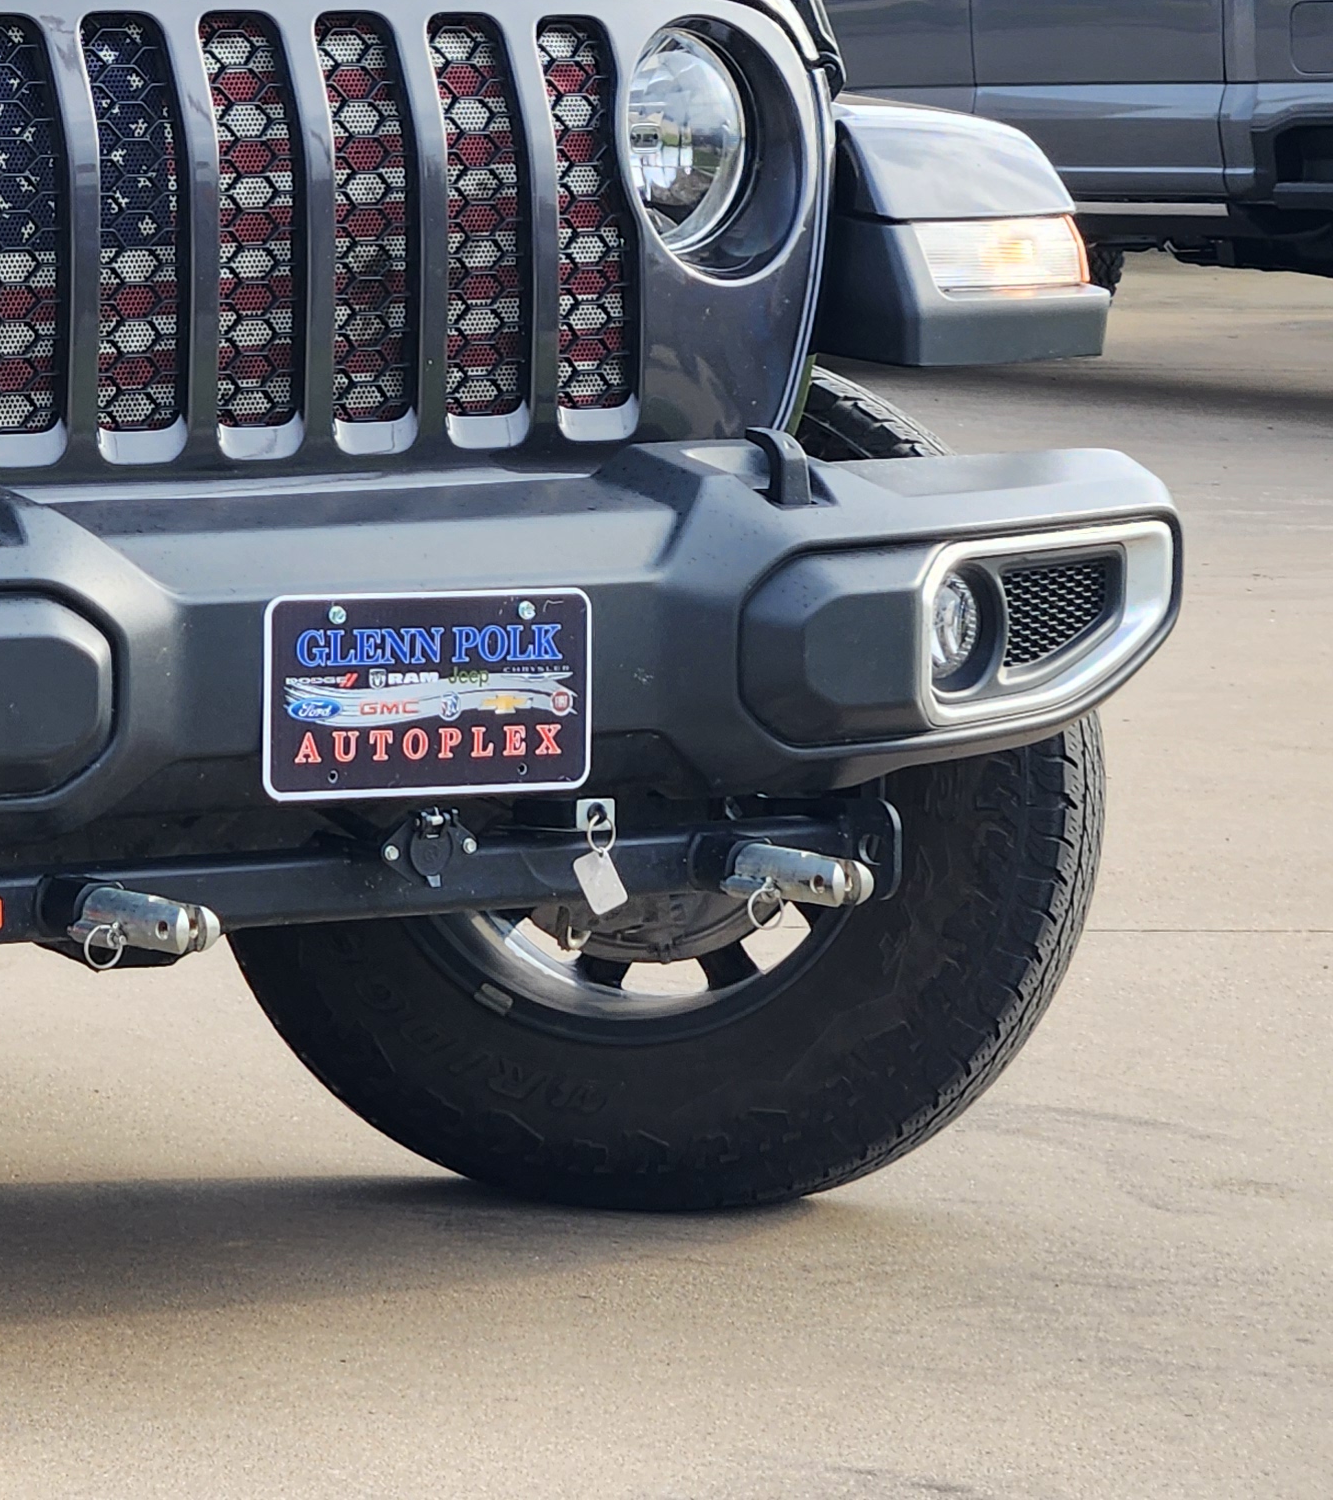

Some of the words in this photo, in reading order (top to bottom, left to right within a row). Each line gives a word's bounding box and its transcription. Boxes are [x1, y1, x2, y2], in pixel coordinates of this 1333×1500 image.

[296, 627, 442, 667] GLENN
[452, 623, 564, 664] POLK
[284, 674, 346, 687] DODGE
[388, 671, 439, 685] RAM
[447, 666, 490, 688] Jeep
[501, 664, 571, 673] CHRYSLER
[297, 699, 334, 720] Ford
[359, 699, 421, 716] GMC
[293, 723, 564, 765] AUTOPLEX
